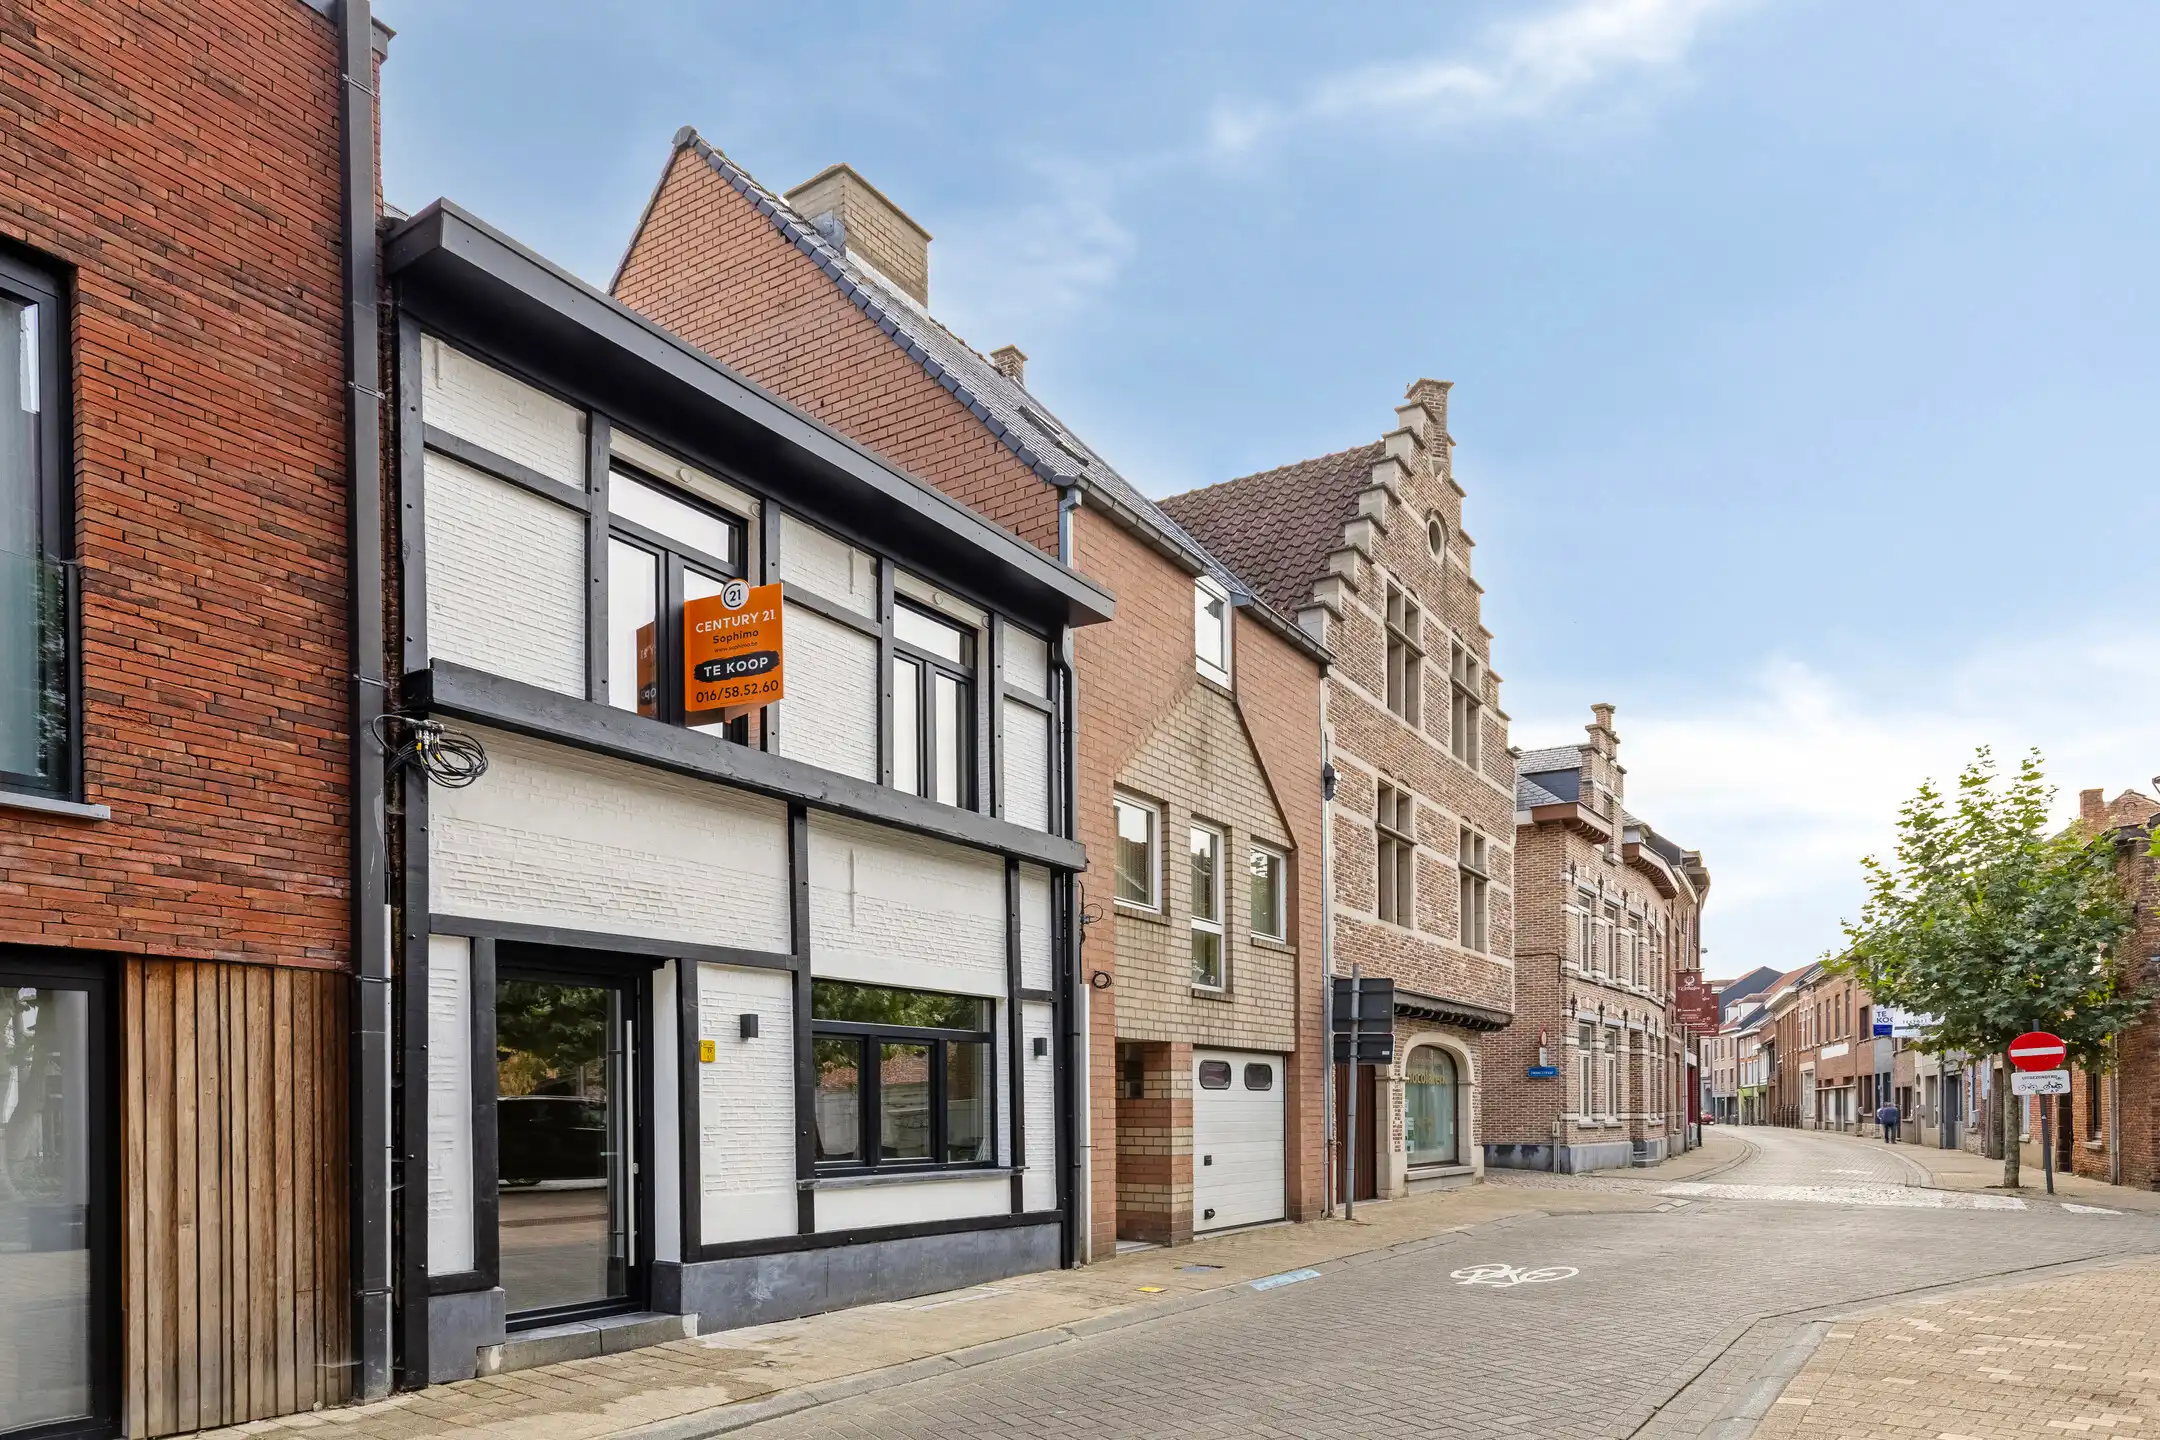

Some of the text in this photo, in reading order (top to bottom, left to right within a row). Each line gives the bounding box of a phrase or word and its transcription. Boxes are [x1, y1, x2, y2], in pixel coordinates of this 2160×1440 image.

[729, 589, 741, 602] 21
[695, 608, 775, 633] CENTURY 21
[712, 630, 759, 644] Sophimo
[703, 657, 769, 677] TE KOOP
[696, 680, 779, 703] 016/58.52.60
